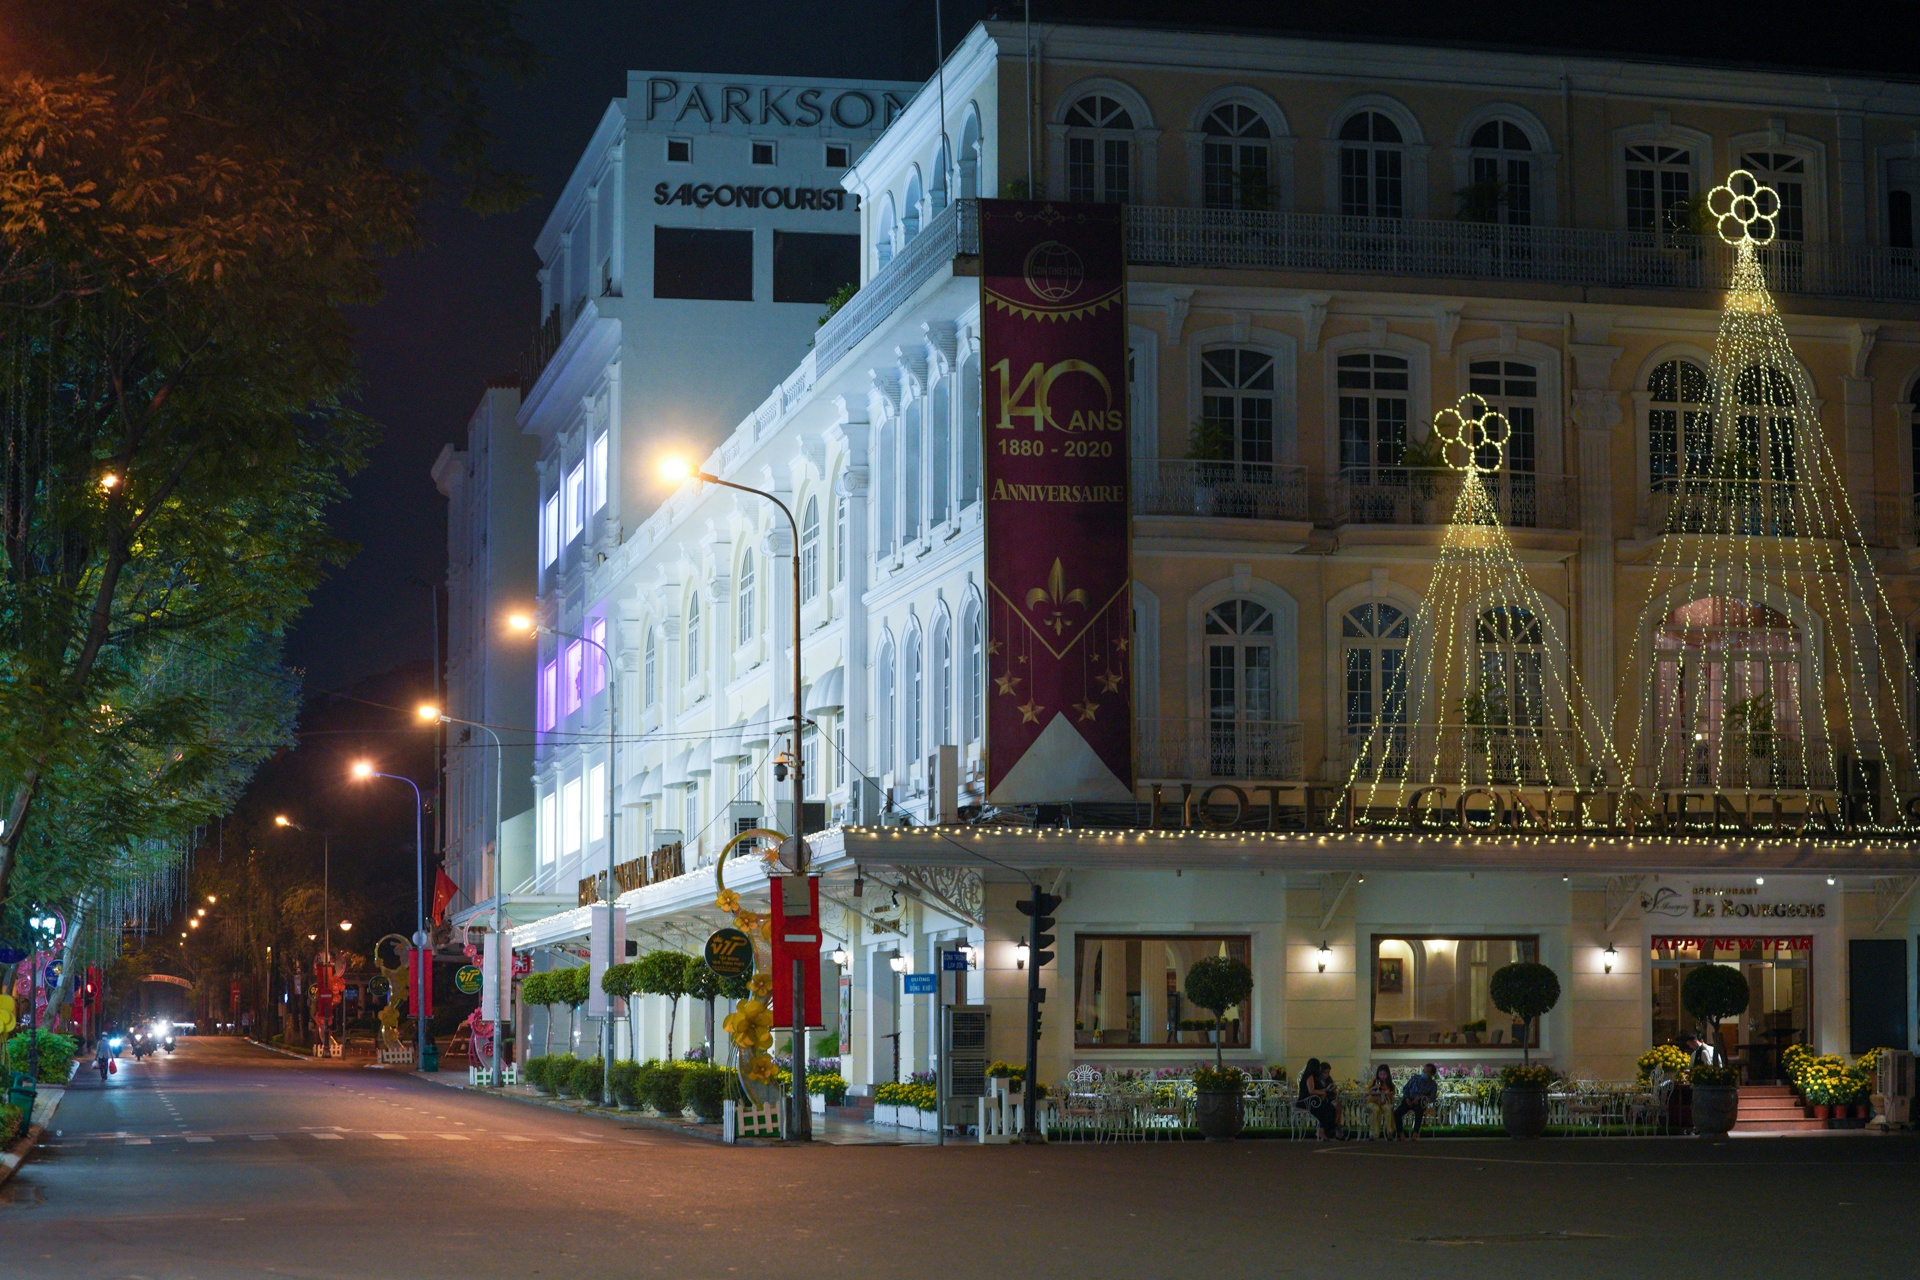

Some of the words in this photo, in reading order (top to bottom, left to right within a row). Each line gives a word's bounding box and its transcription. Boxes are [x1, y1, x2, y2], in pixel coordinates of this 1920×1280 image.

[654, 183, 847, 211] SAIGONTOURIST
[989, 358, 1112, 434] 140
[1068, 410, 1123, 432] ANS
[998, 439, 1045, 457] 1880
[1064, 441, 1113, 457] 2020
[1150, 783, 1374, 834] HOTEL
[1713, 937, 1756, 951] NEW
[1763, 937, 1812, 951] YEAR
